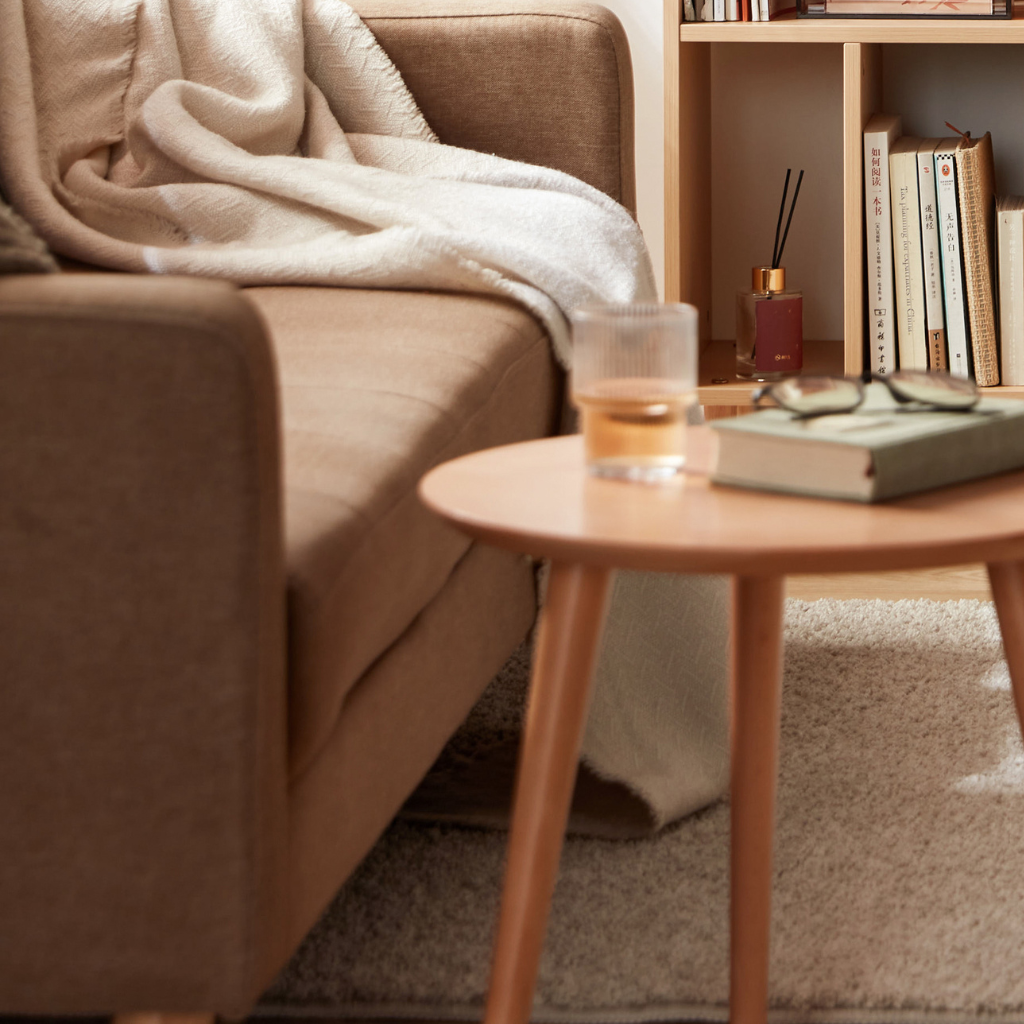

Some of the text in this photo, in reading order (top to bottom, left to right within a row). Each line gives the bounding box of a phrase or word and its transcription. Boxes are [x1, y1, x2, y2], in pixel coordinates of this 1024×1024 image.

[871, 147, 882, 216] 如何阅读一本书
[900, 186, 908, 200] Tax
[899, 202, 909, 238] planning
[924, 204, 935, 230] 道德经
[945, 213, 955, 252] 无声告白
[903, 241, 911, 252] for
[902, 253, 913, 296] expatriates
[906, 298, 914, 307] in
[877, 319, 887, 374] 商务印书馆
